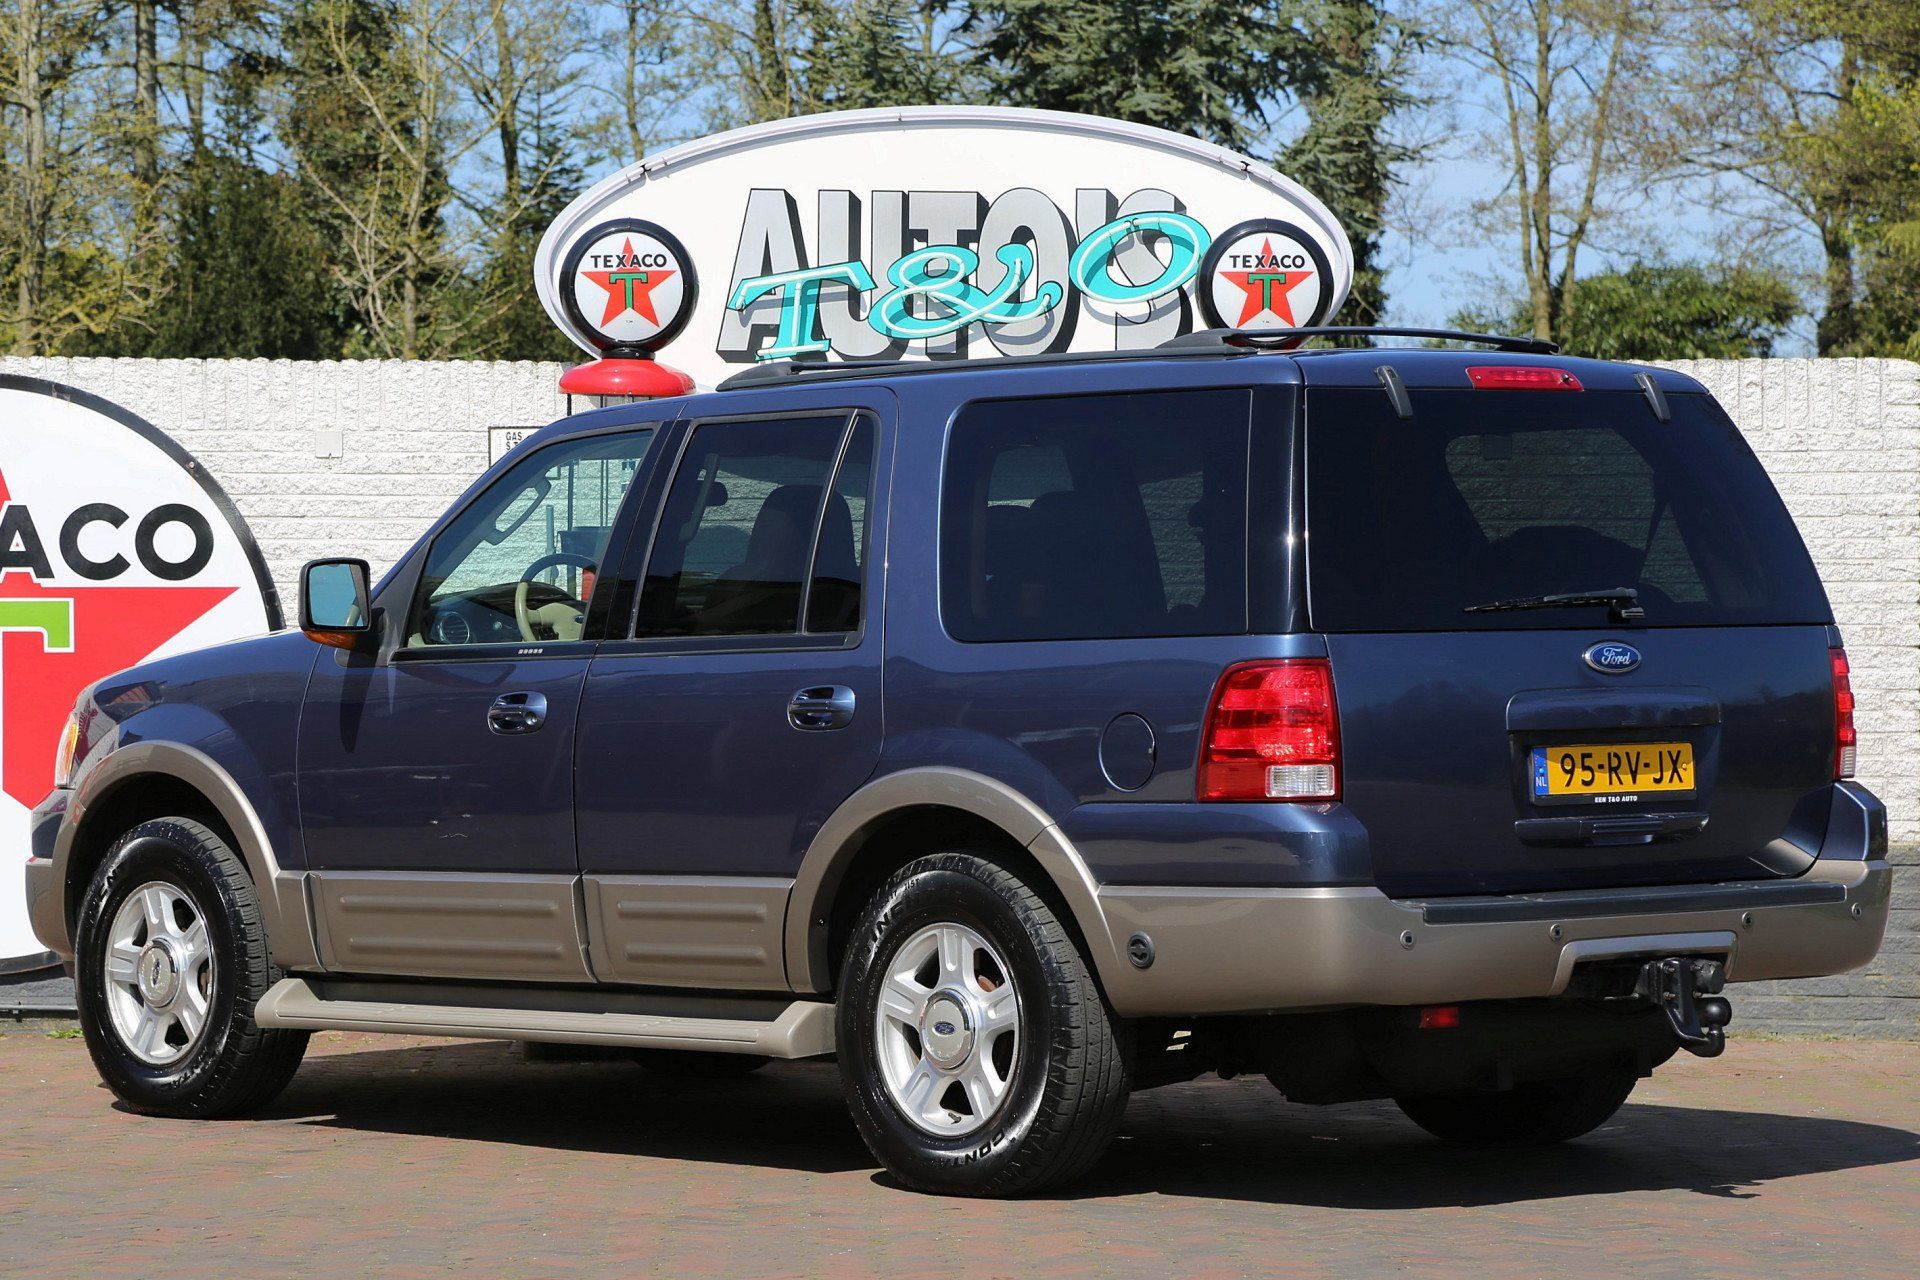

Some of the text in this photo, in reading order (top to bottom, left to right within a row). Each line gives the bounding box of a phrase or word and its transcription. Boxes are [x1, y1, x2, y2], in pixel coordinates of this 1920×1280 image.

[590, 253, 667, 268] TEXACO
[1229, 254, 1305, 269] TEXACO
[506, 432, 522, 441] GAS
[1602, 647, 1631, 664] Ford
[1560, 750, 1683, 787] 95-RV-JX
[1536, 777, 1547, 787] NL
